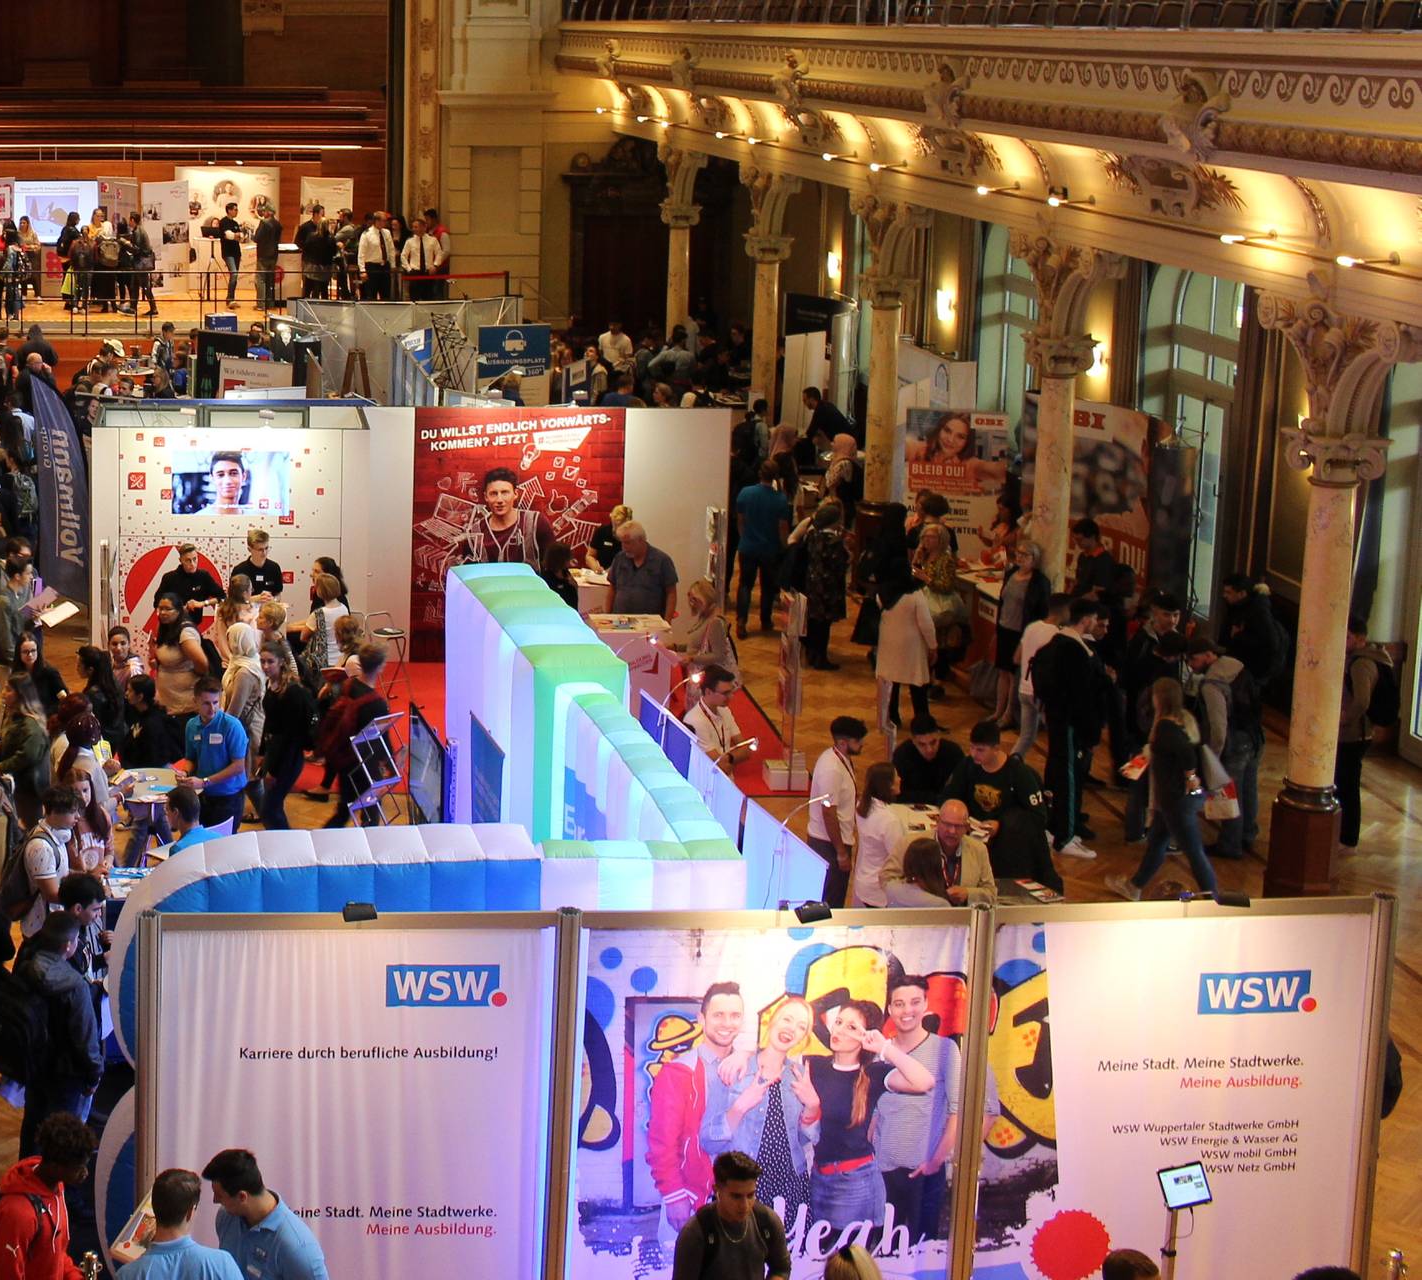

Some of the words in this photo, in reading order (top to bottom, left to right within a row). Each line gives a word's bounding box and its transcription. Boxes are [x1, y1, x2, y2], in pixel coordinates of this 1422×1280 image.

[486, 357, 546, 365] USBILDUNGSPLATZ
[421, 428, 438, 440] DU
[441, 425, 483, 438] WILLST
[485, 419, 538, 434] ENDLICH
[540, 413, 612, 430] VORWÄRTS-
[1073, 409, 1107, 431] BI
[430, 436, 490, 452] KOMMEN?
[492, 433, 529, 447] JETZT
[911, 463, 944, 476] BLEIB
[945, 465, 965, 478] DU!
[51, 428, 84, 568] Vollmann
[1029, 790, 1044, 806] 67
[393, 970, 489, 1001] WSW
[1206, 976, 1300, 1009] WSW
[239, 1047, 293, 1060] Karriere
[298, 1047, 335, 1060] durch
[340, 1046, 409, 1059] berufliche
[413, 1046, 498, 1061] Ausbildung!
[1097, 1059, 1139, 1072] Meine
[1142, 1058, 1179, 1071] Stadt.
[1184, 1057, 1226, 1070] Meine
[1229, 1053, 1304, 1069] Stadtwerke.
[1180, 1076, 1222, 1089] Meine
[1226, 1074, 1303, 1089] Ausbildung.
[1112, 1124, 1140, 1134] WSW
[1143, 1121, 1206, 1134] Wuppertaler
[1208, 1120, 1264, 1131] Stadtwerke
[1267, 1119, 1300, 1129] GmbH
[1160, 1136, 1188, 1146] WSW
[1191, 1136, 1229, 1147] Energie
[1232, 1136, 1240, 1145] &
[1243, 1134, 1279, 1144] Wasser
[1282, 1133, 1298, 1143] AG
[1201, 1149, 1230, 1160] WSW
[1233, 1148, 1261, 1158] mobil
[1264, 1147, 1297, 1158] GmbH
[1205, 1163, 1234, 1174] WSW
[1237, 1162, 1260, 1173] Netz
[1263, 1161, 1296, 1171] GmbH
[293, 1206, 321, 1218] eine
[325, 1206, 364, 1218] Stadt.
[369, 1206, 413, 1218] Meine
[417, 1205, 498, 1218] Stadtwerke.
[366, 1224, 410, 1236] Meine
[414, 1223, 497, 1238] Ausbildung.
